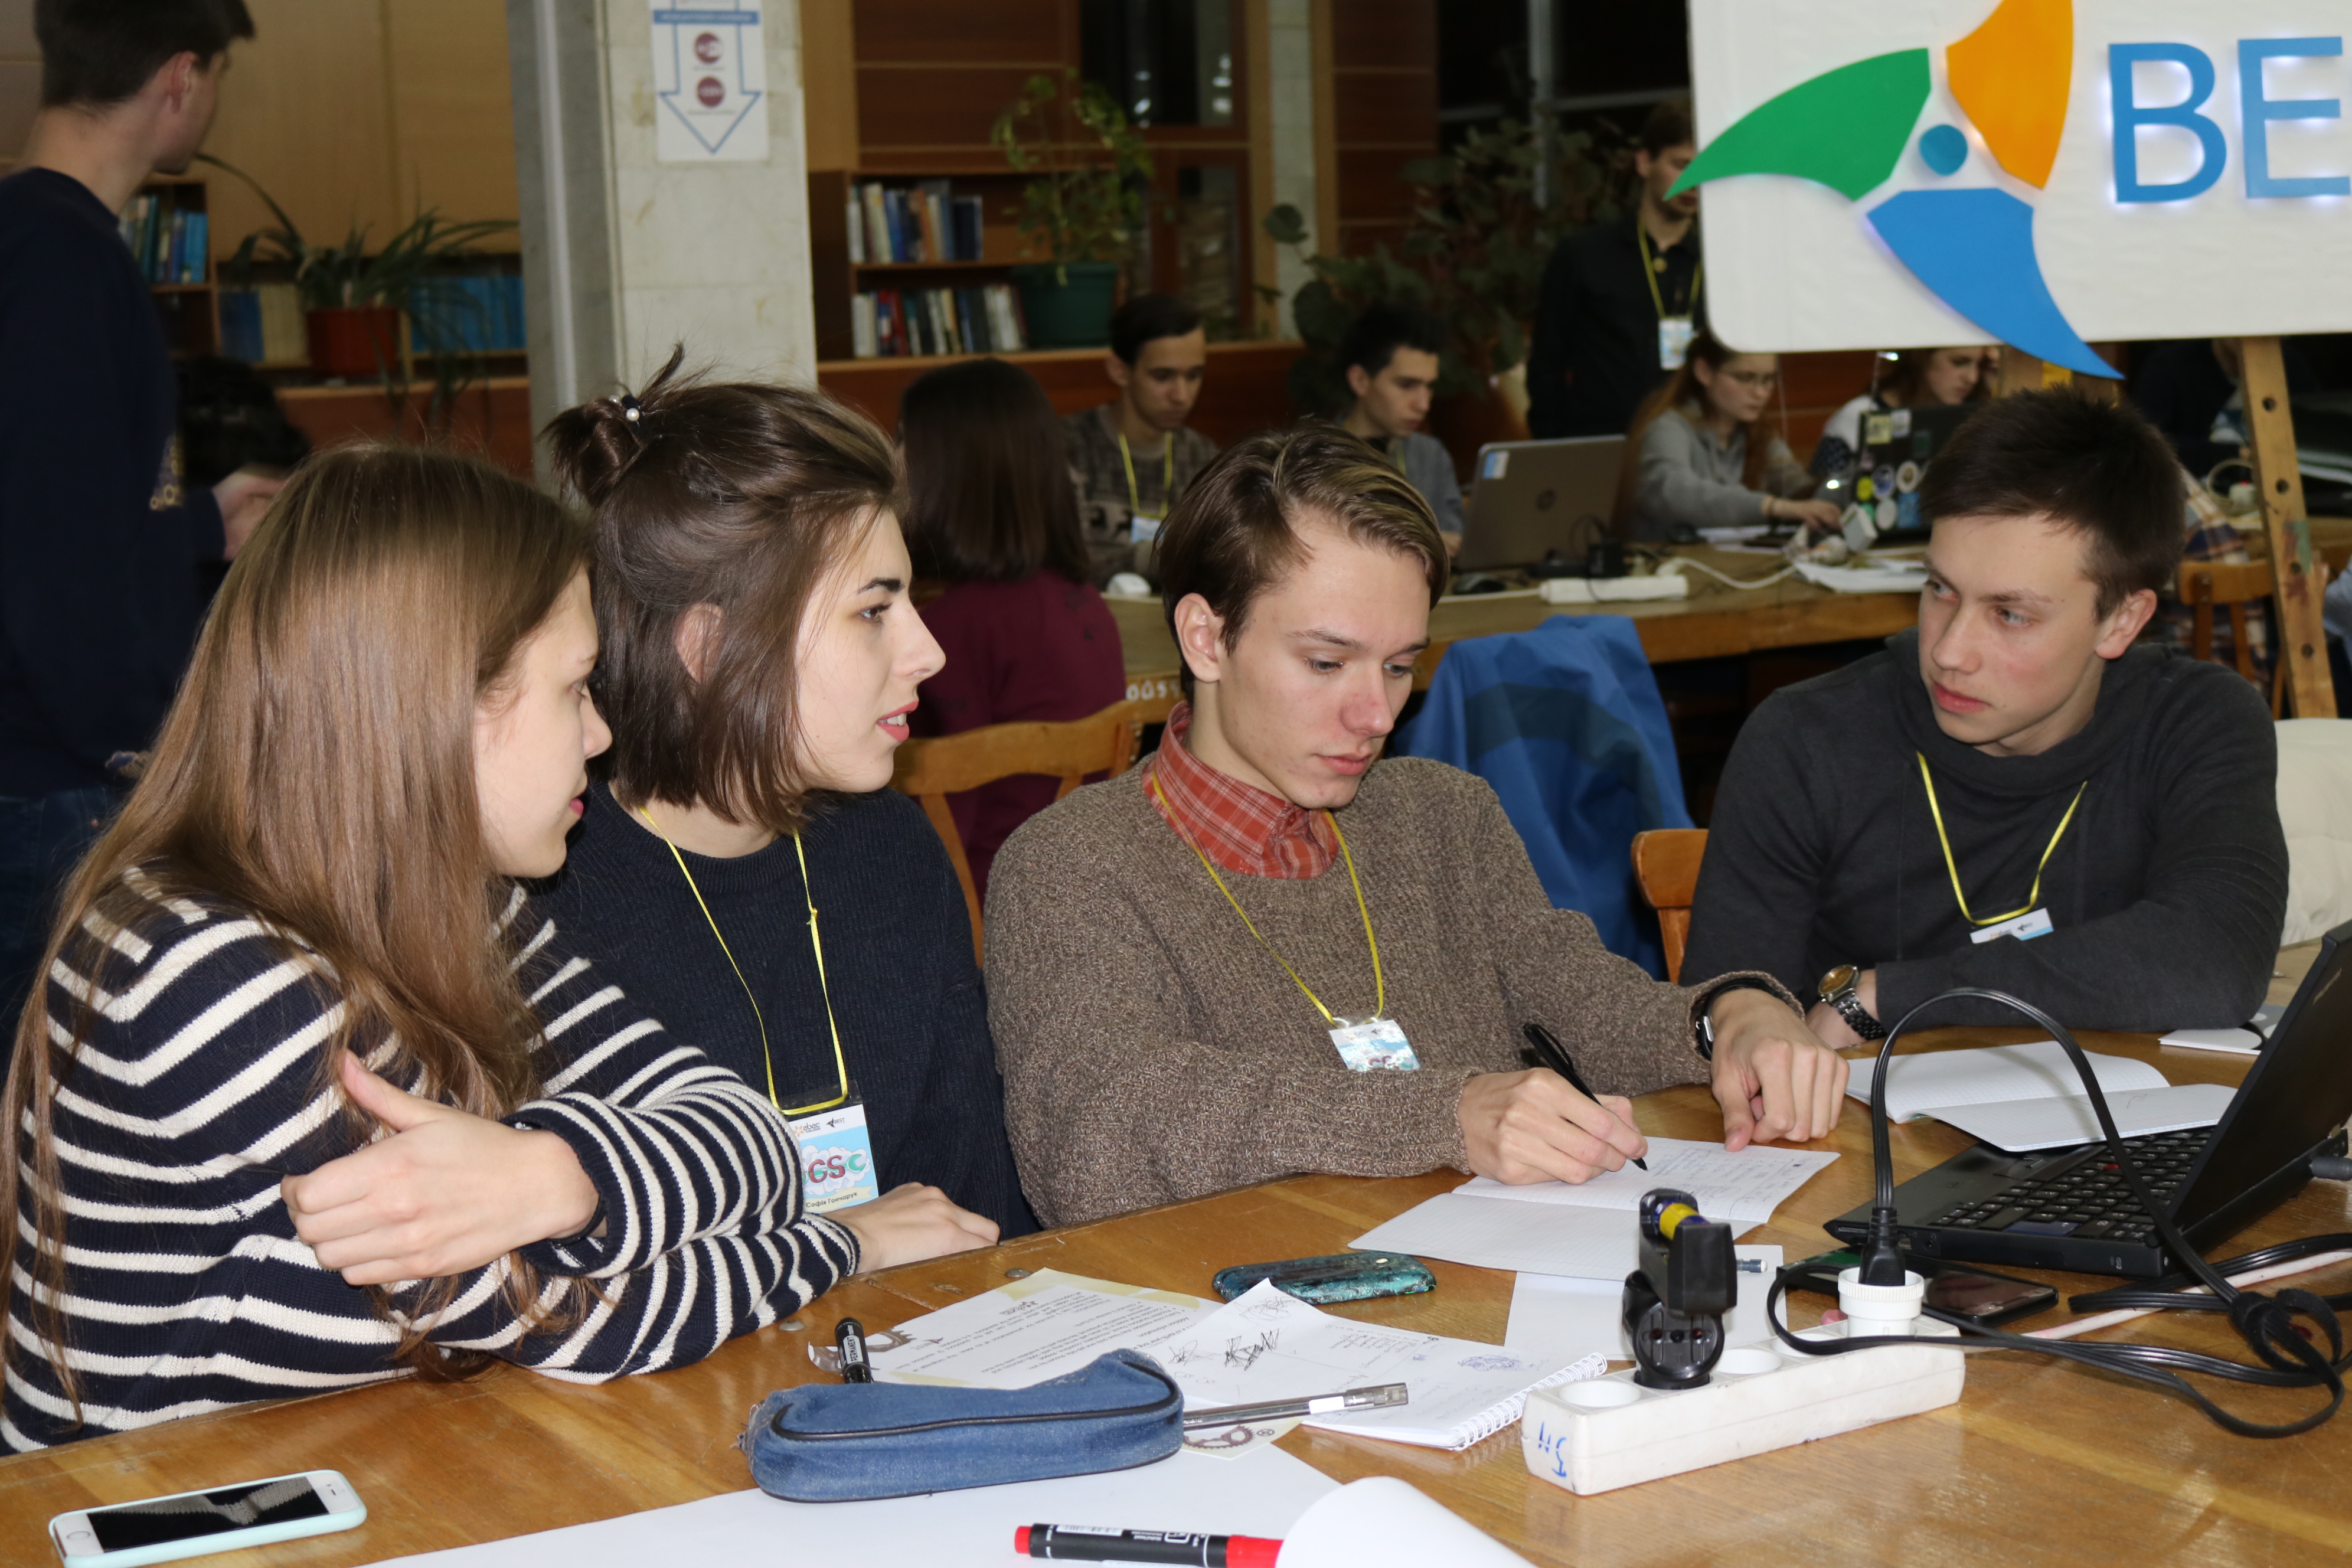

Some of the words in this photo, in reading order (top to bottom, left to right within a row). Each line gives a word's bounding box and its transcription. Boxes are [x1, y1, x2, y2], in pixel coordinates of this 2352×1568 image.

[2108, 36, 2351, 204] BE
[806, 1200, 827, 1208] Софія
[828, 1191, 858, 1204] Гончарук
[847, 1337, 858, 1362] PERMANENT
